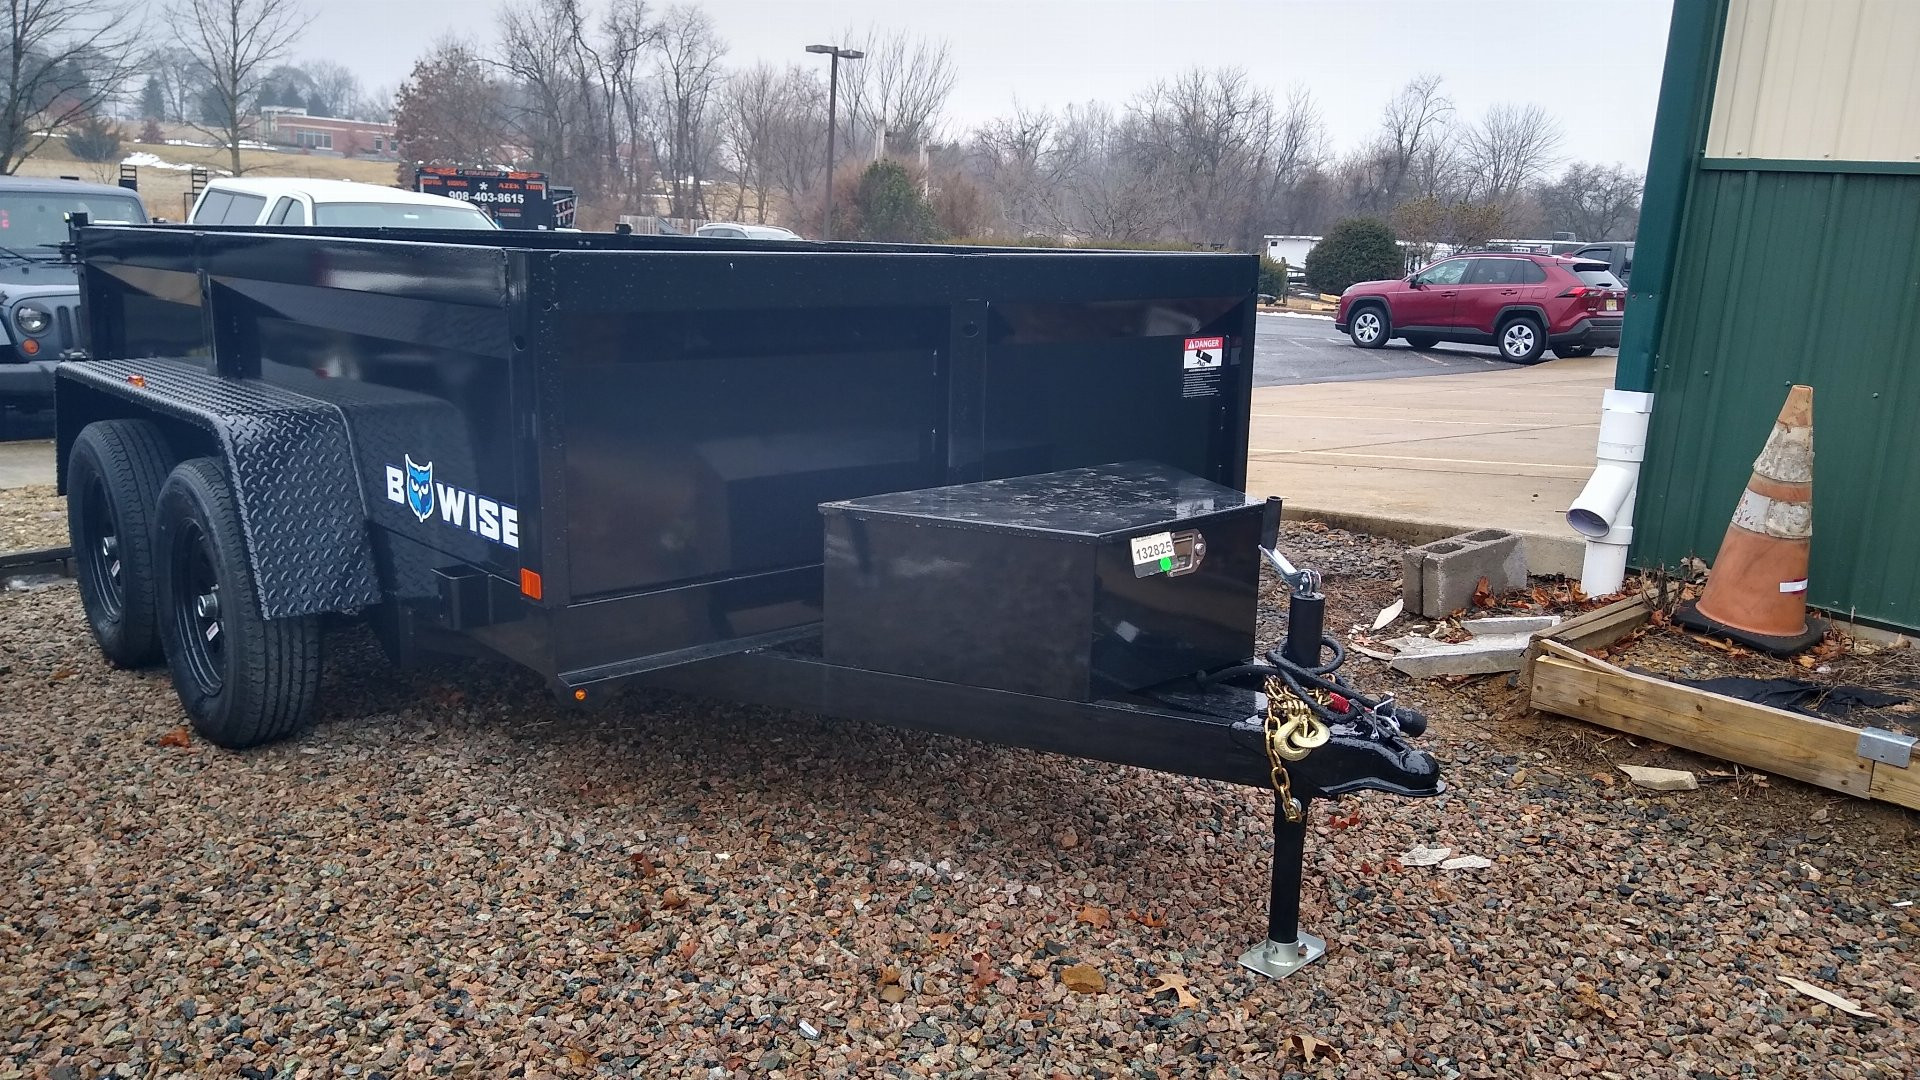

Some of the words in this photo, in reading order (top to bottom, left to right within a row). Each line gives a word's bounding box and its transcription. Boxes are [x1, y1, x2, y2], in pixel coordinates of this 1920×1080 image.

[448, 190, 525, 204] 908-403-8615
[1194, 339, 1220, 348] DANGER
[1136, 541, 1173, 560] 132825
